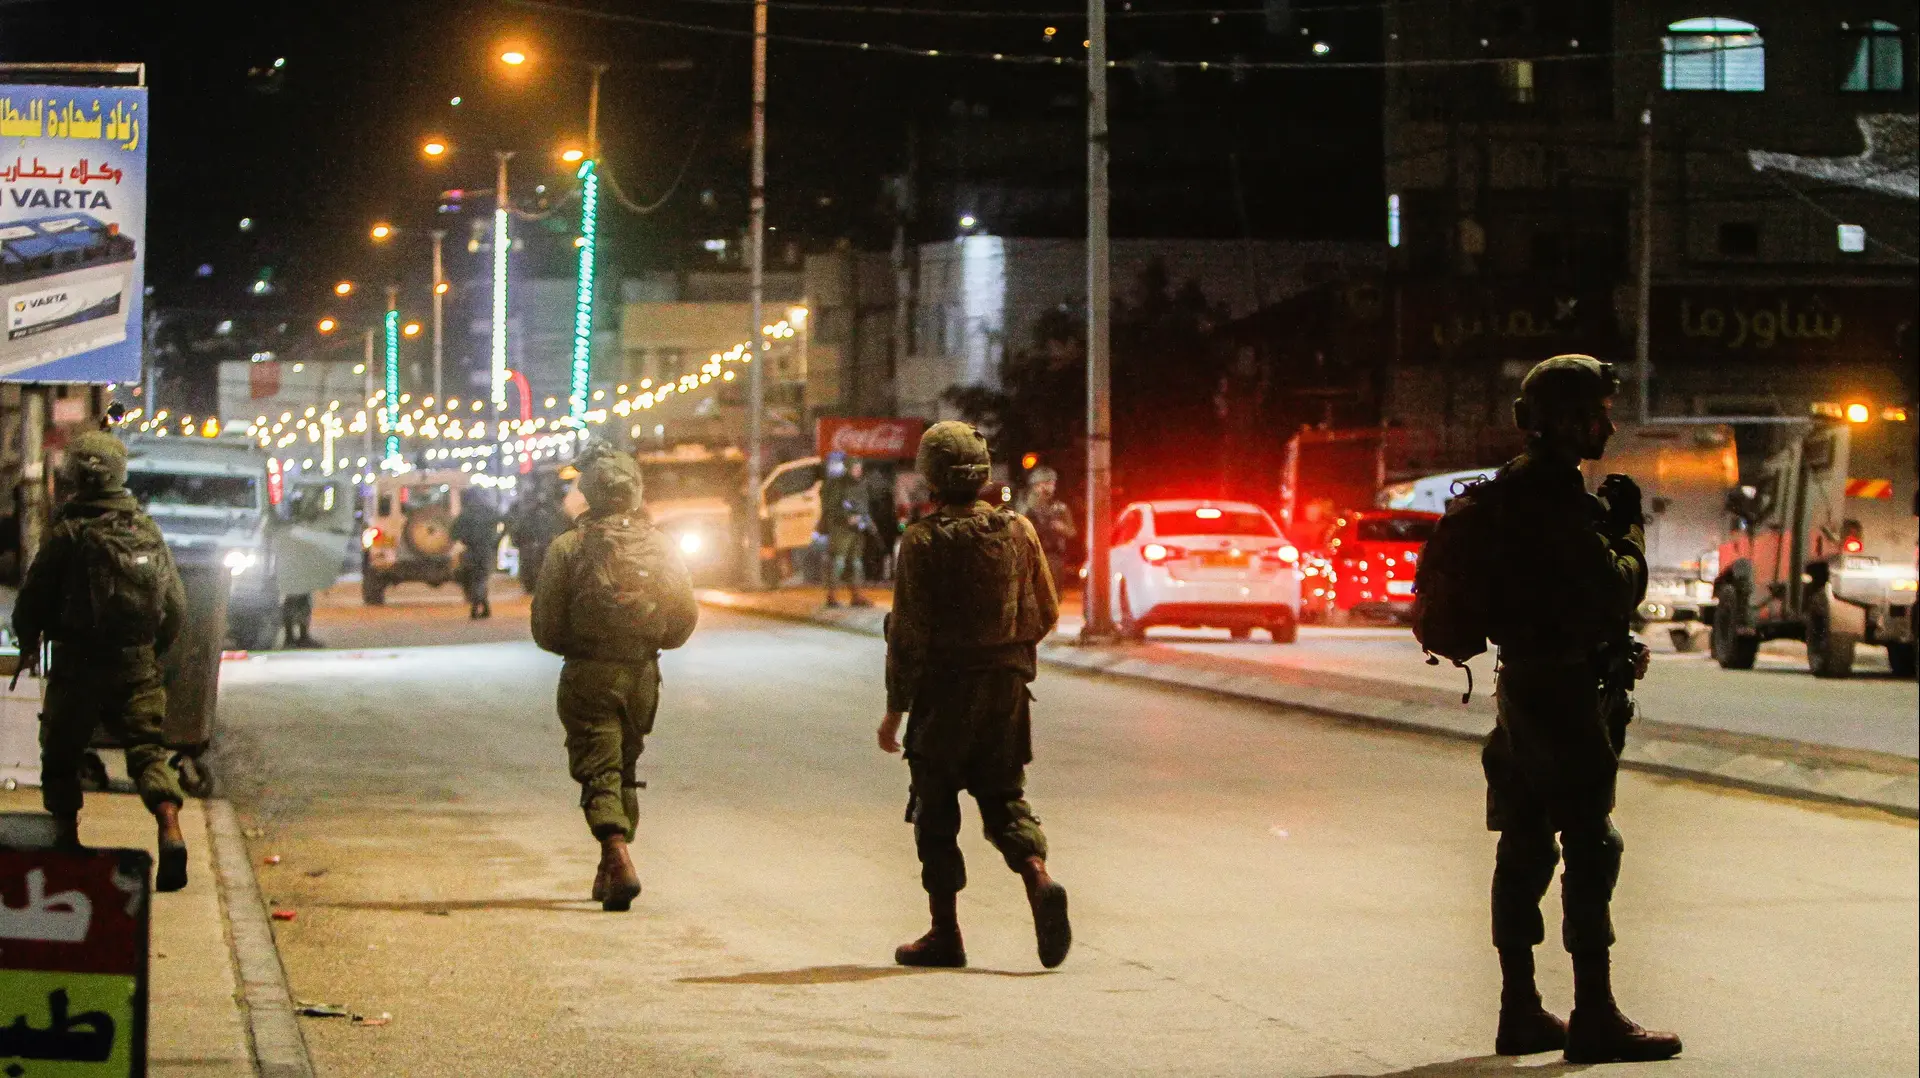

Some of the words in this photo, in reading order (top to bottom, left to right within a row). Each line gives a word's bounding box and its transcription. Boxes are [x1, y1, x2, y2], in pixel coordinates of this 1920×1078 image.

[47, 98, 102, 139] شحادة
[106, 99, 139, 151] زياد
[69, 158, 122, 185] وكلاء
[10, 188, 112, 209] VARTA
[29, 292, 68, 308] VARTA
[1681, 295, 1843, 349] شاورما
